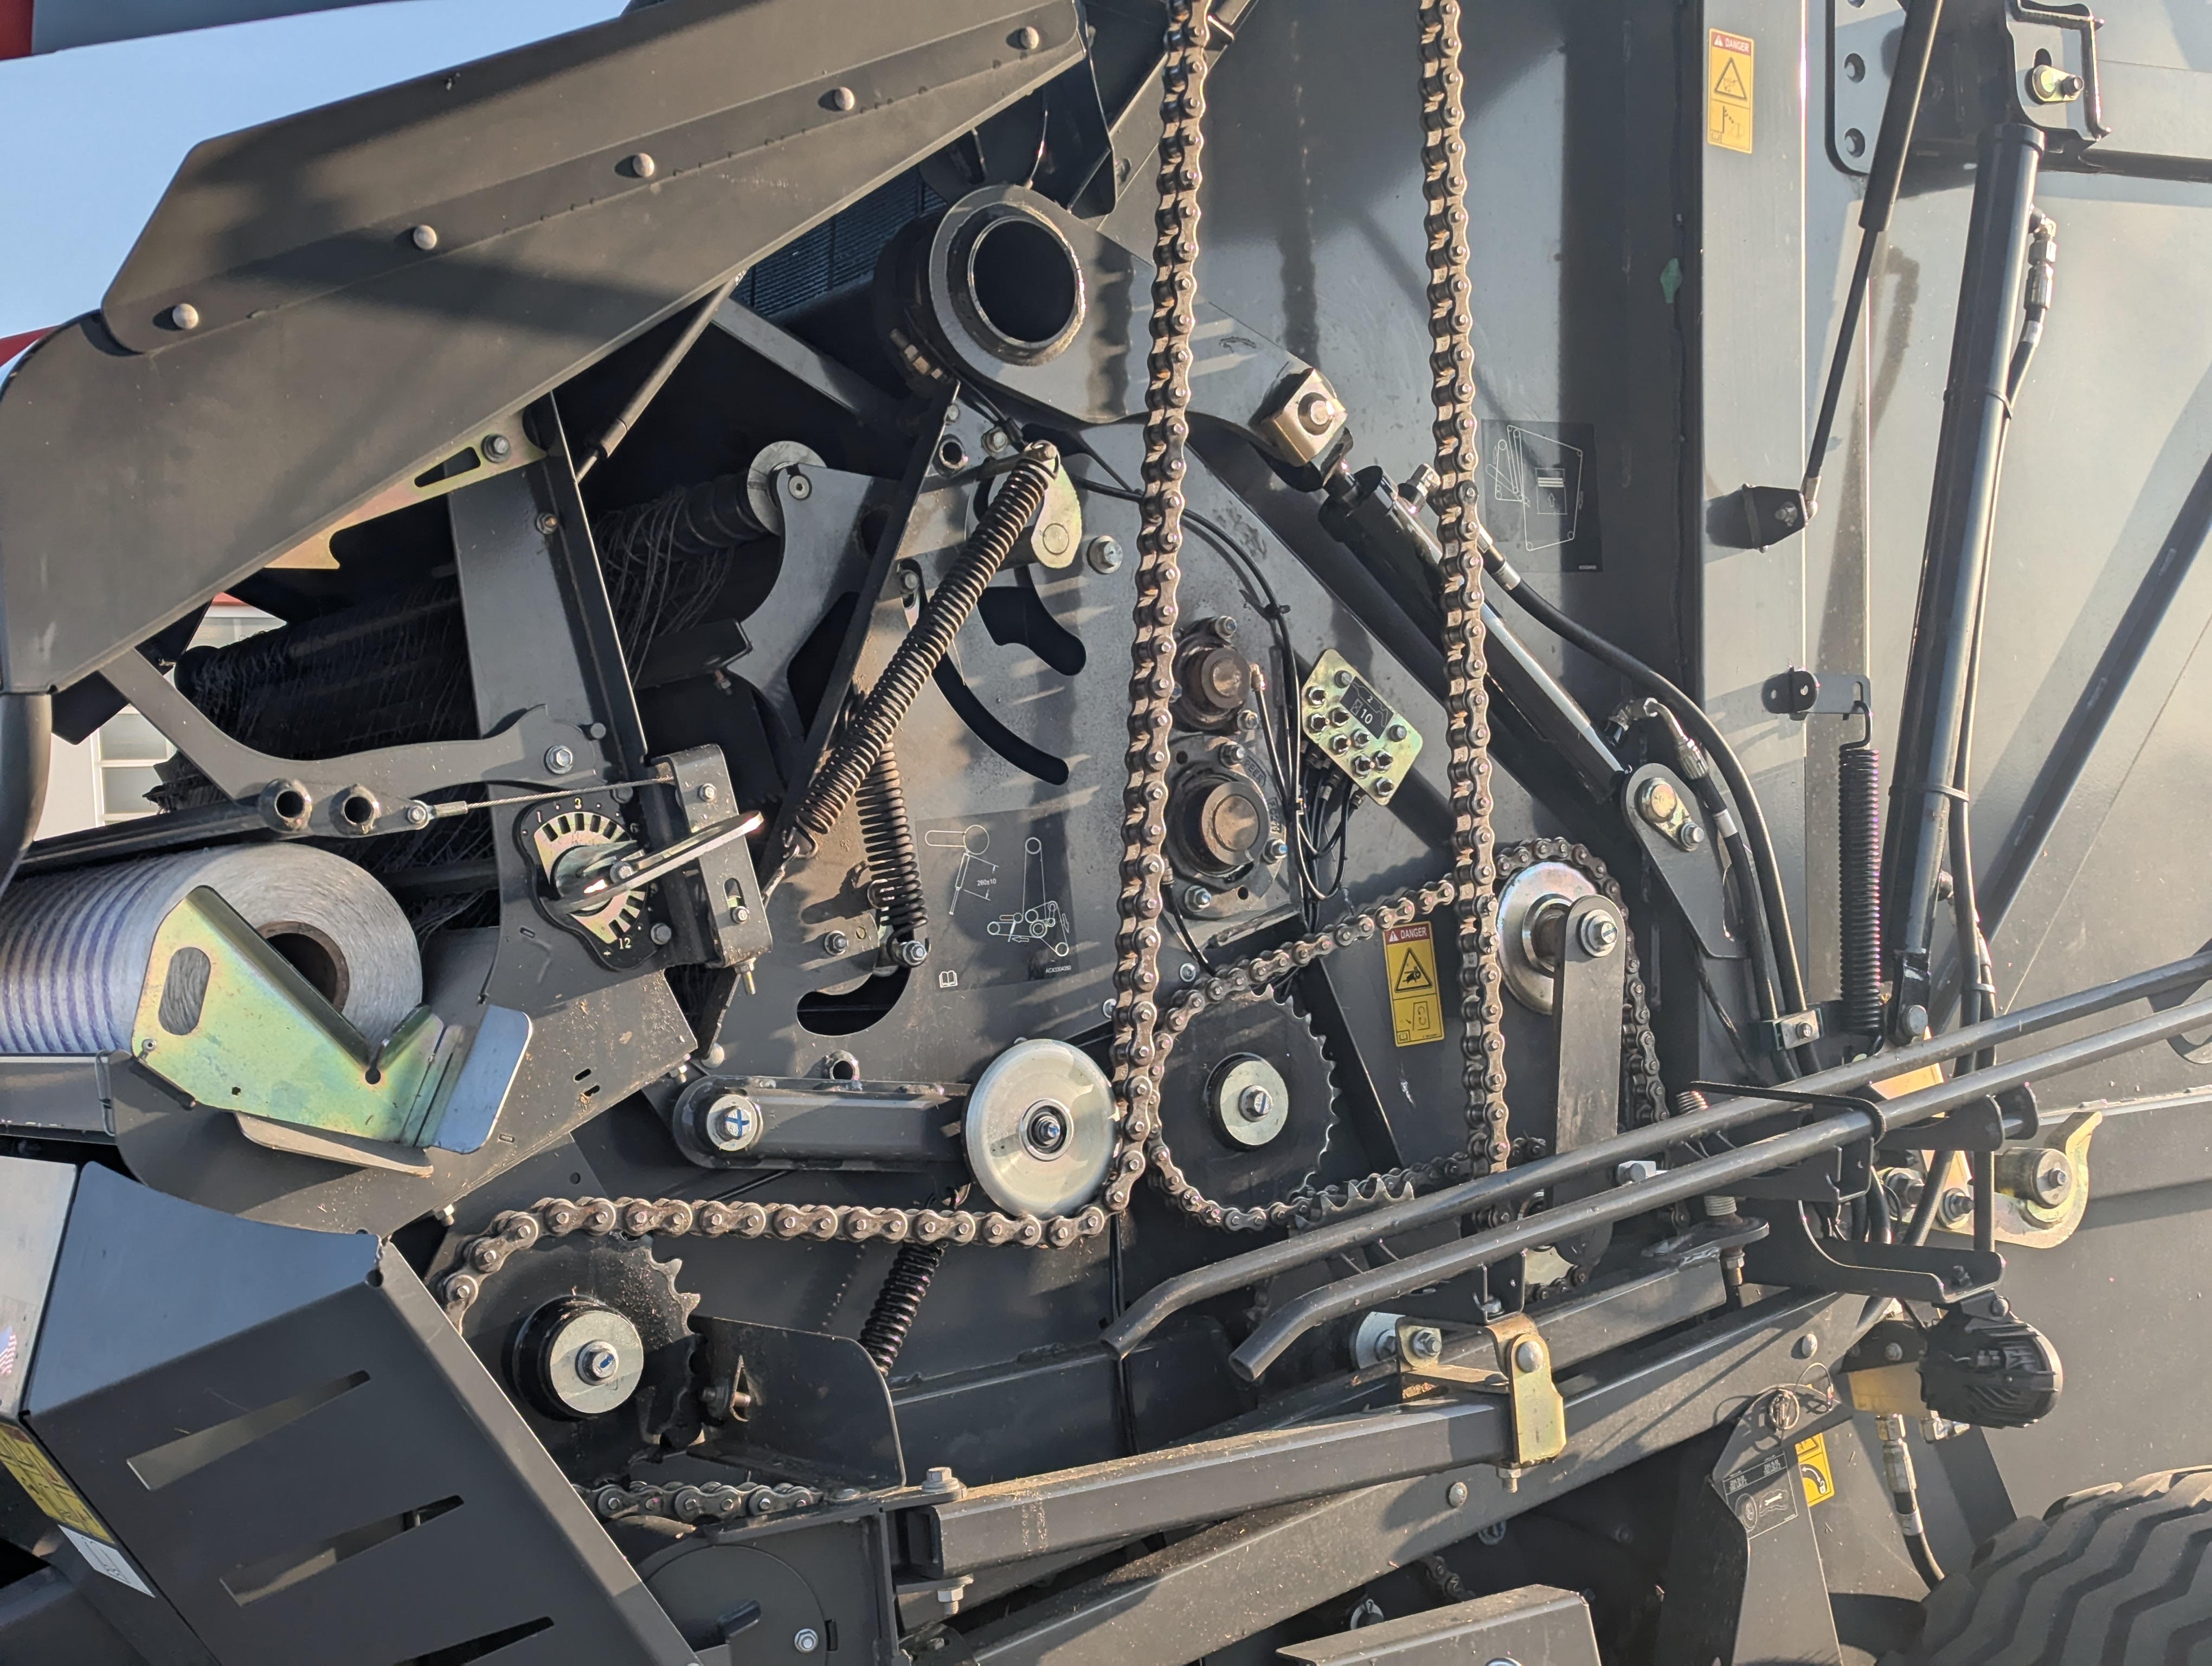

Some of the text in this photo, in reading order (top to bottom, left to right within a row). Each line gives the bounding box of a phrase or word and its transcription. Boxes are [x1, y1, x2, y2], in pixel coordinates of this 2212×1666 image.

[1725, 37, 1749, 52] DANGER
[1367, 695, 1373, 703] 2
[1361, 708, 1373, 724] 10
[575, 798, 583, 809] 3
[1400, 927, 1426, 939] DANGER
[619, 938, 632, 949] 12
